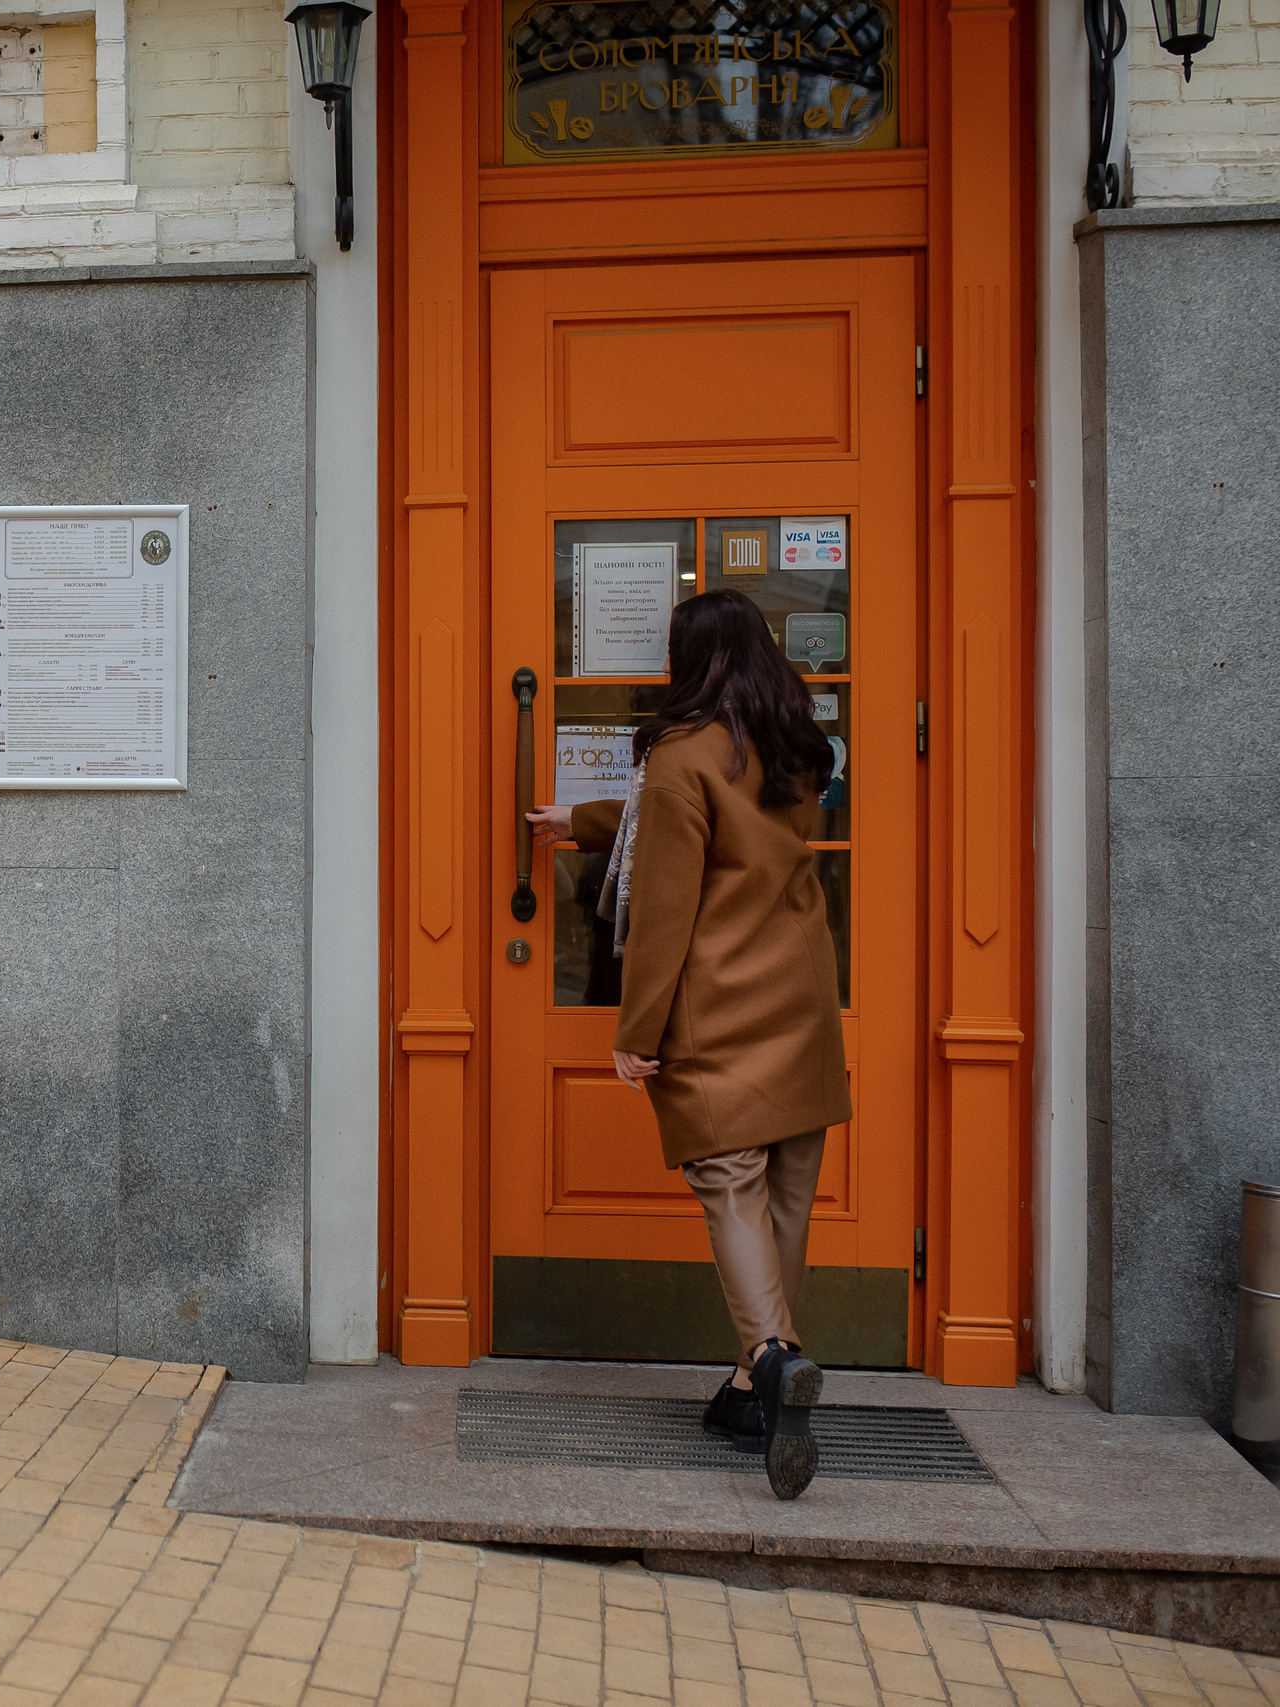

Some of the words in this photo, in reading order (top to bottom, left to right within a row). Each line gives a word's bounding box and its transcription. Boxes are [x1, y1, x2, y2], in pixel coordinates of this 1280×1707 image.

[598, 73, 799, 112] БРОВАРНЯ
[785, 532, 811, 542] VISA
[819, 530, 840, 539] VISA
